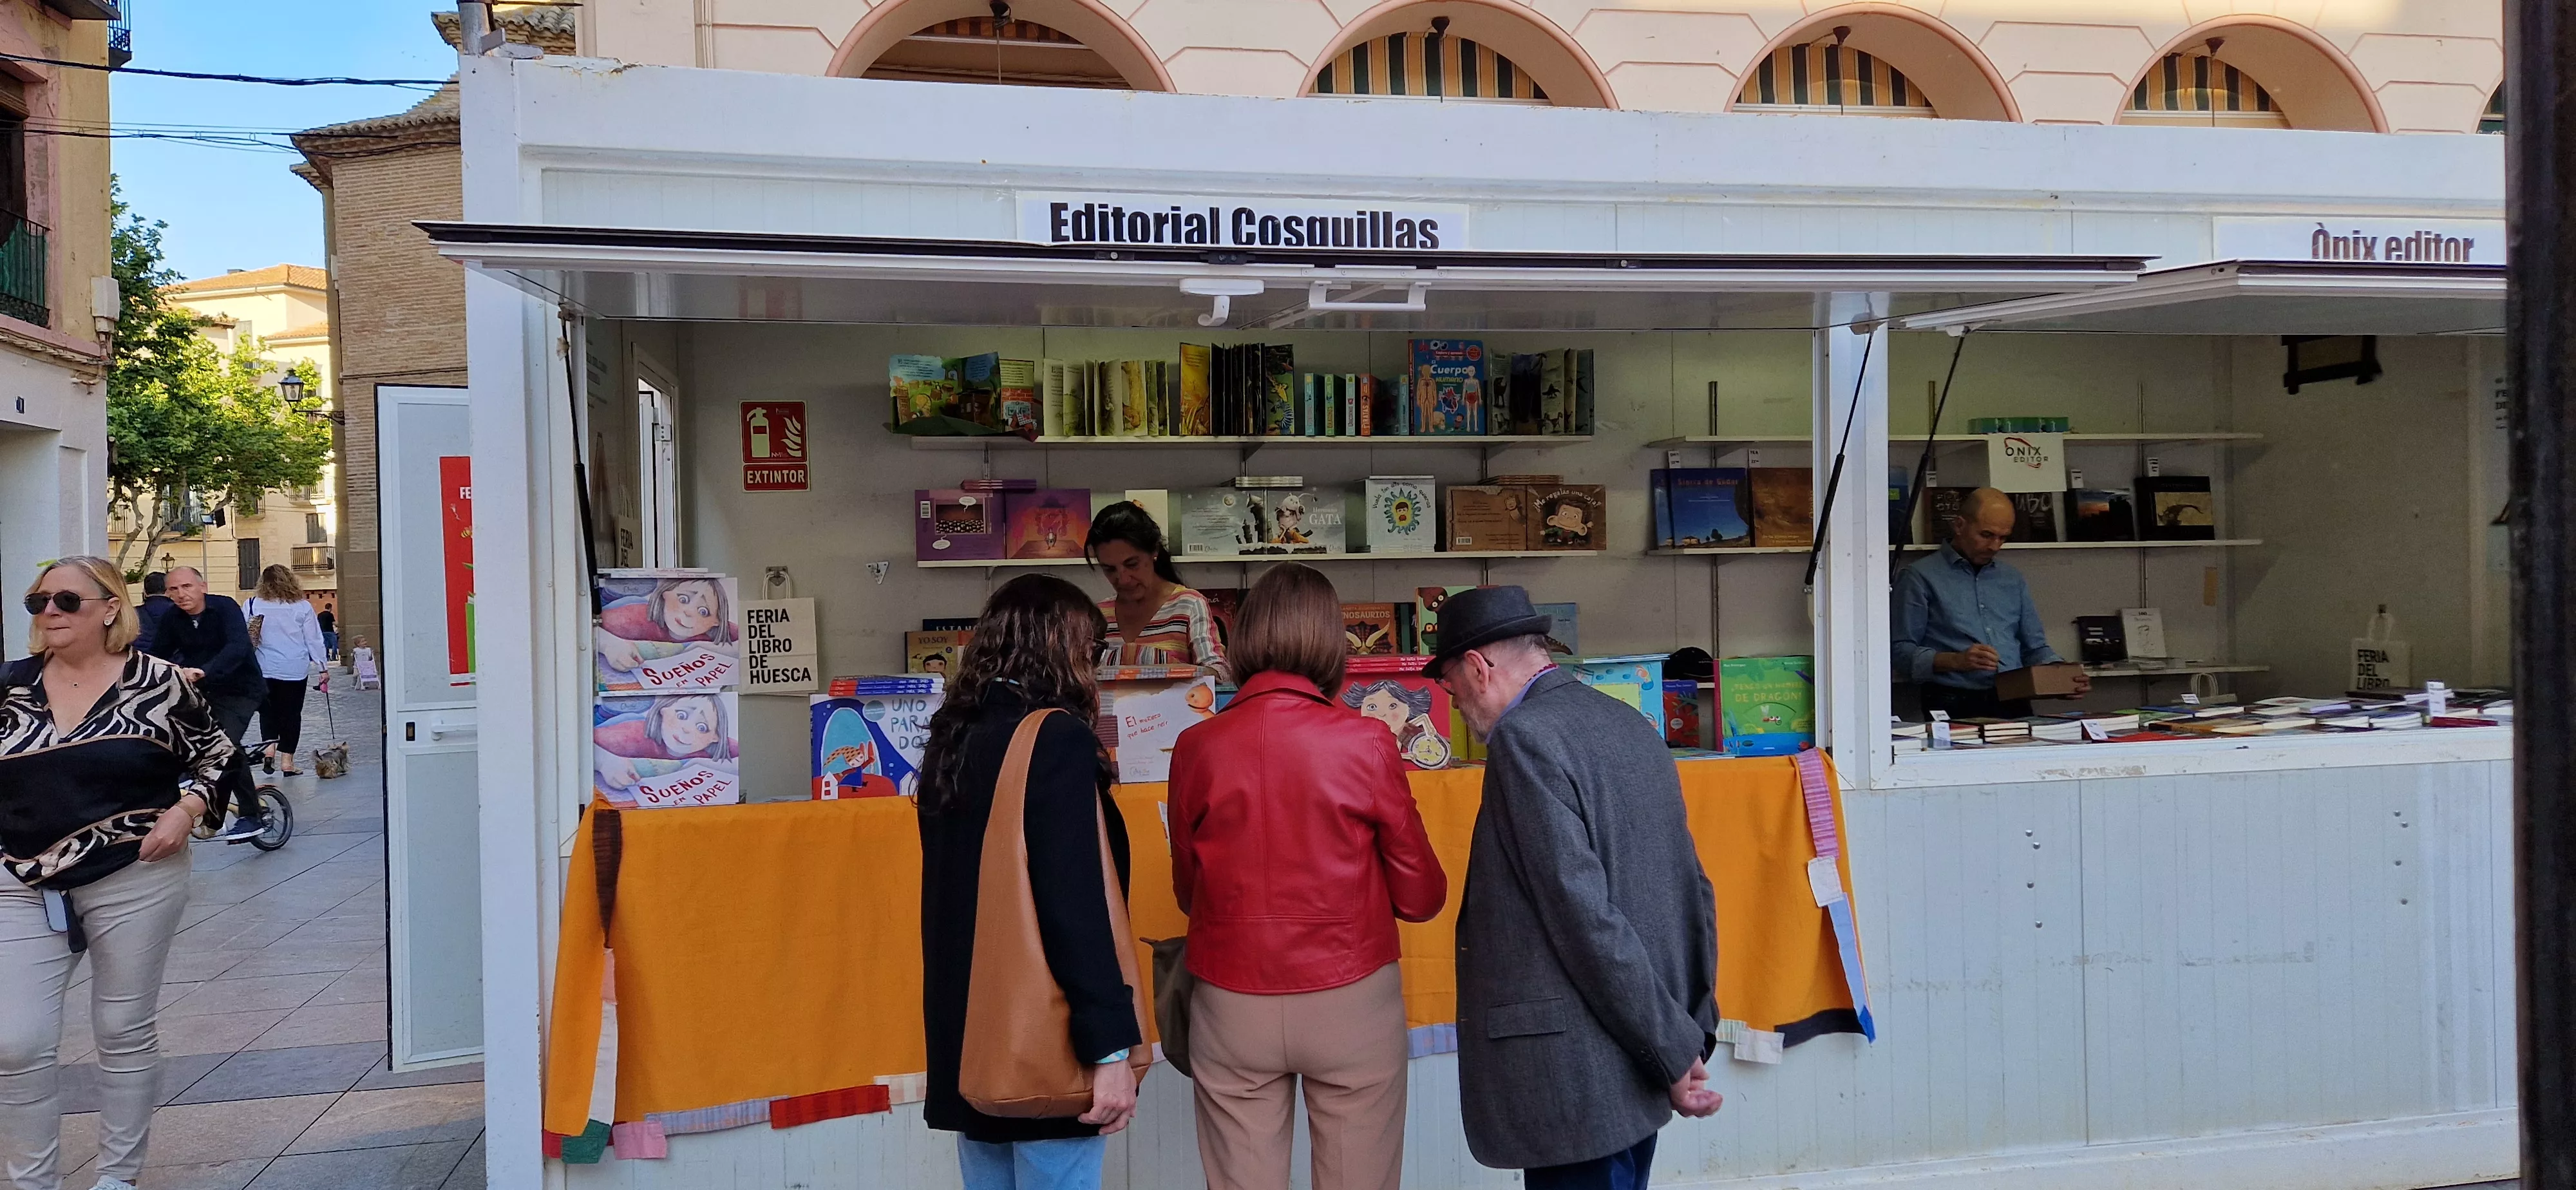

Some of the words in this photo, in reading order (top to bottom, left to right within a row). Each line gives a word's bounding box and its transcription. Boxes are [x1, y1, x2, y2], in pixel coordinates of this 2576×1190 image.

[1051, 202, 1220, 245] Editorial
[1233, 207, 1440, 249] Cosquillas
[2385, 231, 2475, 261] editor
[1431, 364, 1467, 376] Cuerpo
[1361, 404, 1370, 429] PIRATAS
[747, 469, 806, 484] EXTINTOR
[1402, 482, 1418, 490] como
[1545, 487, 1569, 502] regalas
[1309, 513, 1342, 525] GATA
[748, 608, 791, 624] FERIA
[748, 624, 775, 639] DEL
[749, 638, 793, 655] LIBRO
[750, 654, 768, 670] DE
[2357, 648, 2391, 663] FERIA
[643, 653, 715, 686] SUEÑOS
[676, 679, 688, 688] EN
[695, 663, 734, 686] PAPEL
[750, 667, 812, 685] HUESCA
[2358, 663, 2378, 677] DEL
[892, 699, 927, 712] UNO
[1735, 694, 1750, 703] DE
[1125, 715, 1137, 728] El
[1127, 729, 1138, 740] que
[1141, 724, 1155, 735] hace
[639, 770, 715, 804] SUEÑOS
[674, 796, 687, 806] EN
[694, 780, 732, 804] PAPEL
